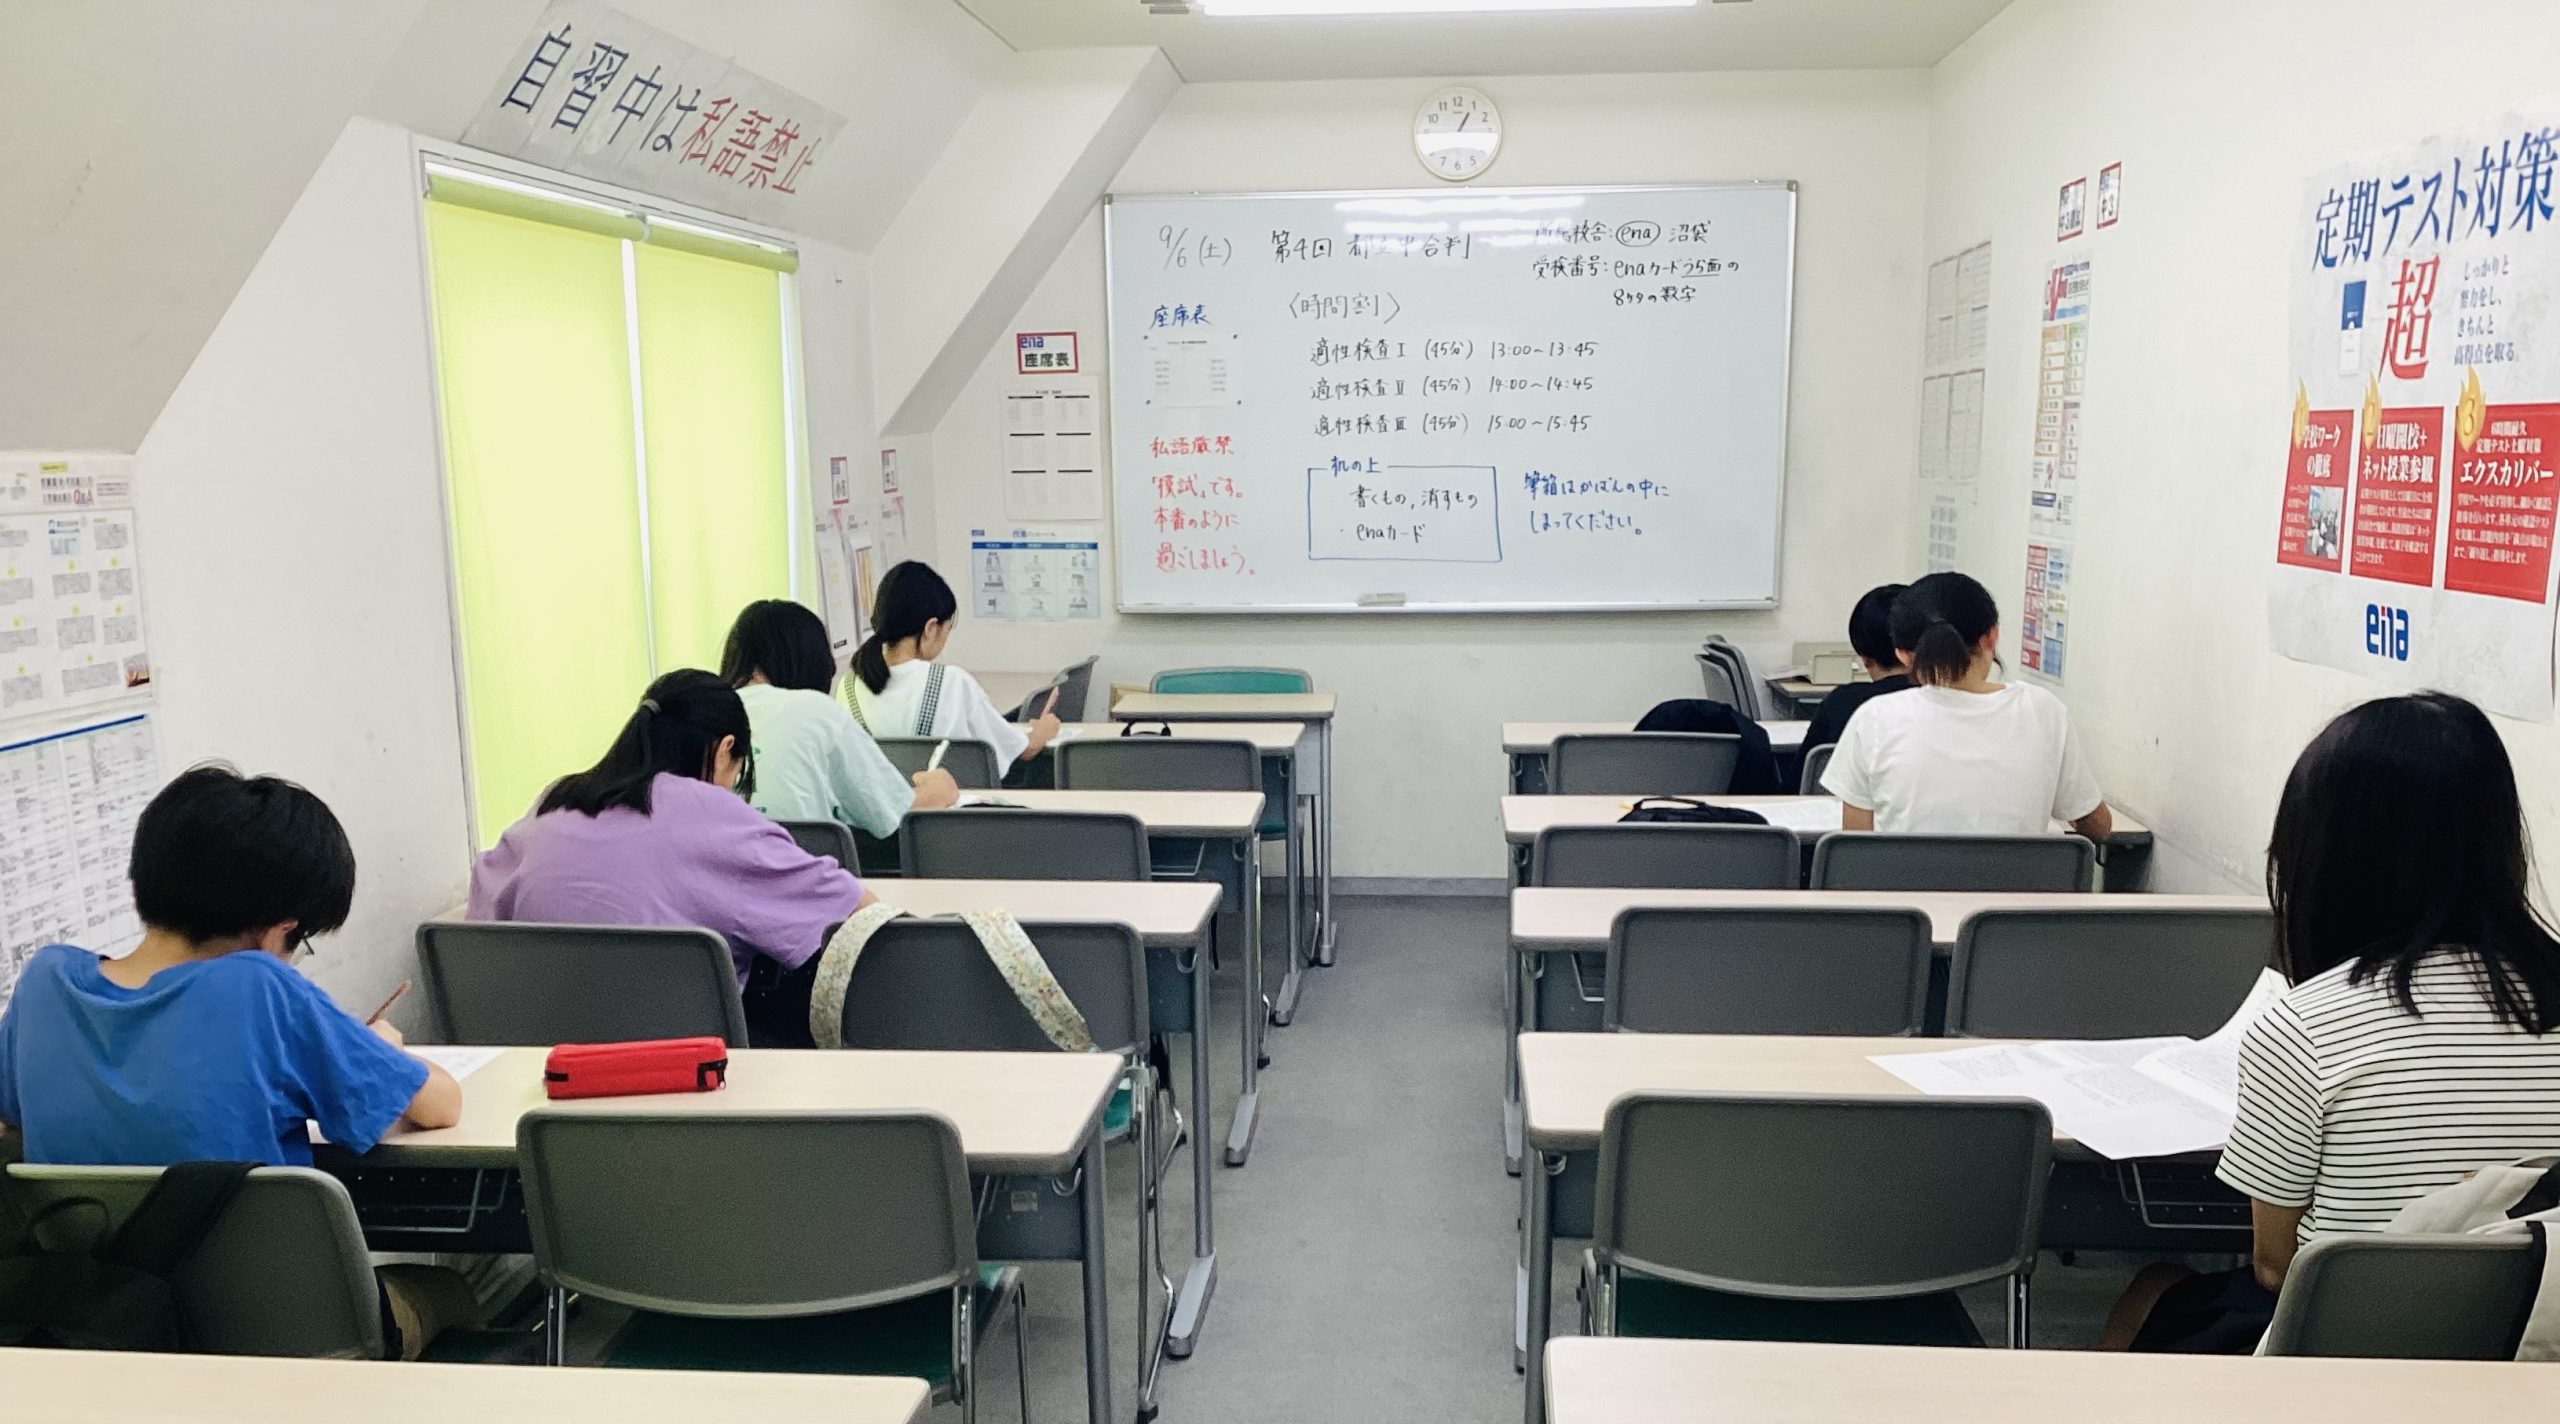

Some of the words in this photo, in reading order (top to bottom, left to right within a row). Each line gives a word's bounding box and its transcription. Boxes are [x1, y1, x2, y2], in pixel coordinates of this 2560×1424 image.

[500, 23, 822, 195] 自習中は私語禁止
[1438, 102, 1448, 111] 11
[1453, 96, 1463, 107] 12
[1428, 113, 1439, 124] 10
[1482, 112, 1488, 122] 2
[1440, 157, 1447, 167] 7
[1455, 160, 1461, 170] 6
[1470, 156, 1476, 166] 5
[2312, 126, 2560, 271] 定期テスト対策
[1668, 220, 1711, 243] 沼袋
[1159, 225, 1188, 271] 9/6
[1199, 235, 1232, 266] (土)
[1271, 230, 1332, 263] 第4回
[2464, 254, 2509, 280] しっかりと
[1150, 304, 1212, 329] 座席表
[2379, 254, 2441, 382] 超
[2458, 314, 2494, 337] きちんと
[1020, 336, 1045, 349] ena
[1425, 340, 1474, 360] (45分)
[1024, 353, 1070, 367] 座席表
[1422, 375, 1471, 397] (45分)
[1422, 412, 1469, 435] (45分)
[2464, 398, 2476, 436] 3
[1149, 435, 1235, 458] 私語厳禁
[1331, 456, 1382, 477] 机の上
[2460, 458, 2554, 488] エクスカリバー
[1523, 470, 1672, 500] 筆箱はかばんの中に
[1153, 507, 1240, 533] 本番のように
[1530, 509, 1643, 536] しまってください。
[1156, 542, 1256, 575] 過ごしましょう。
[2366, 604, 2409, 662] ena
